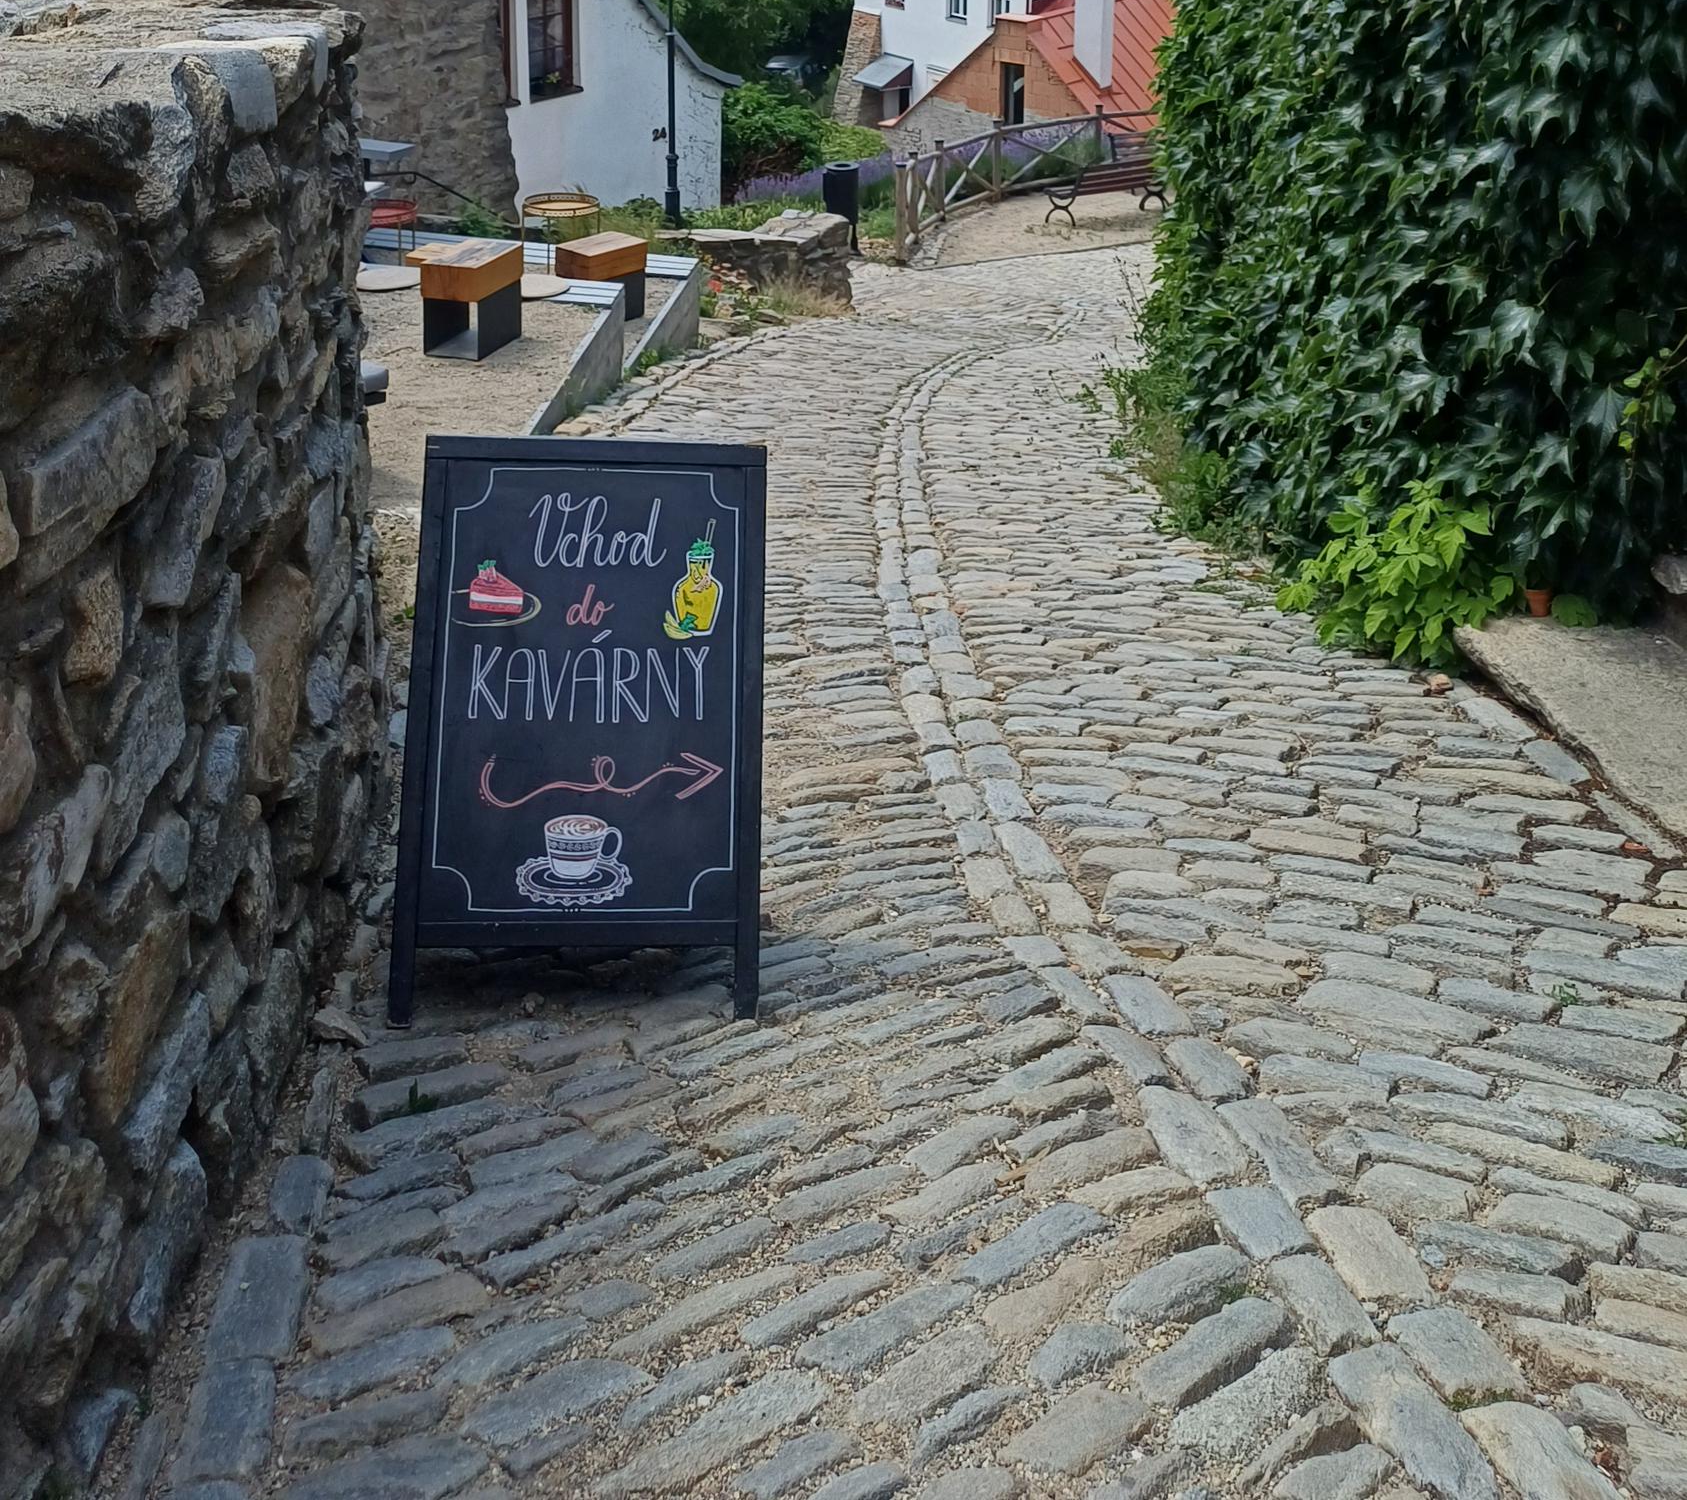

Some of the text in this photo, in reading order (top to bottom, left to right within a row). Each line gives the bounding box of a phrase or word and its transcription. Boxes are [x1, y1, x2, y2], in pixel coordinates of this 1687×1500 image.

[528, 492, 668, 568] Vchod
[565, 583, 616, 626] do
[467, 629, 710, 724] KAVÁRNY
